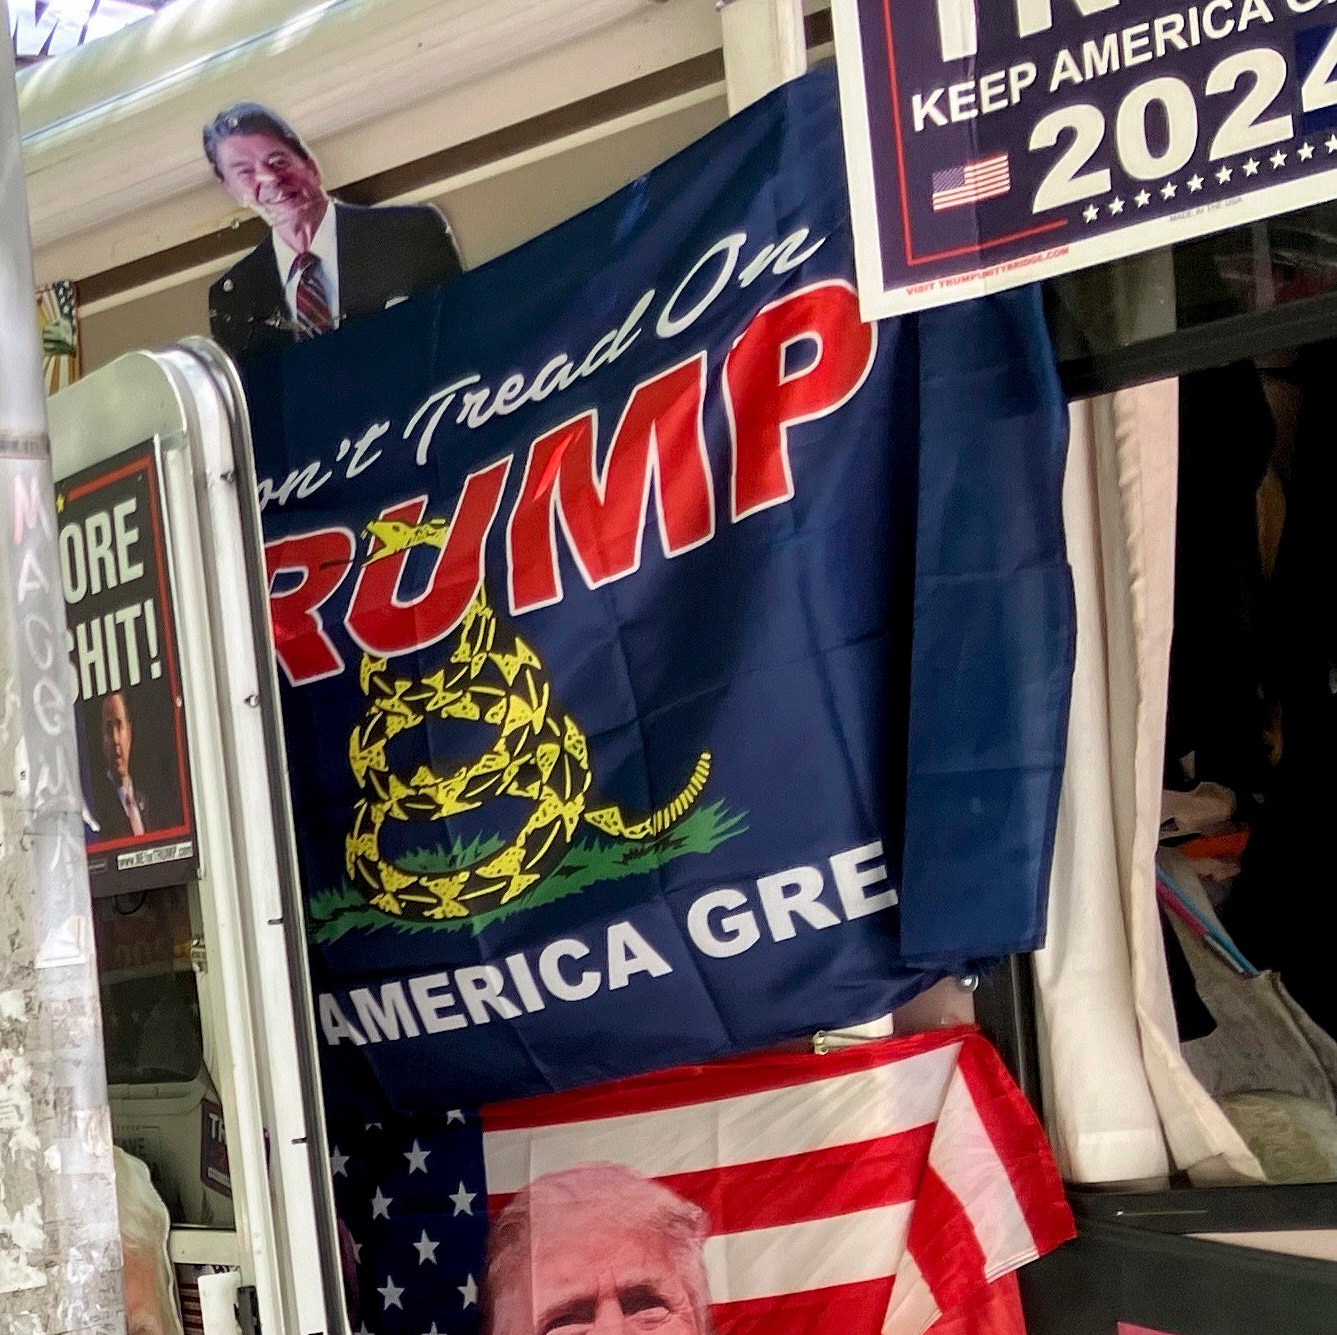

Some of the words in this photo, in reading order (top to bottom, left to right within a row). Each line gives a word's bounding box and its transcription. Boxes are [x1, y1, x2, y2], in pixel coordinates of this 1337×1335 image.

[911, 60, 1038, 133] KEEP
[1048, 0, 1274, 93] AMERICA
[403, 299, 646, 466] Tread
[658, 227, 827, 342] On
[906, 281, 936, 297] VISIT
[59, 497, 145, 605] ORE
[262, 277, 881, 687] RUMP
[320, 919, 674, 1046] AMERICA
[684, 840, 899, 960] GRE
